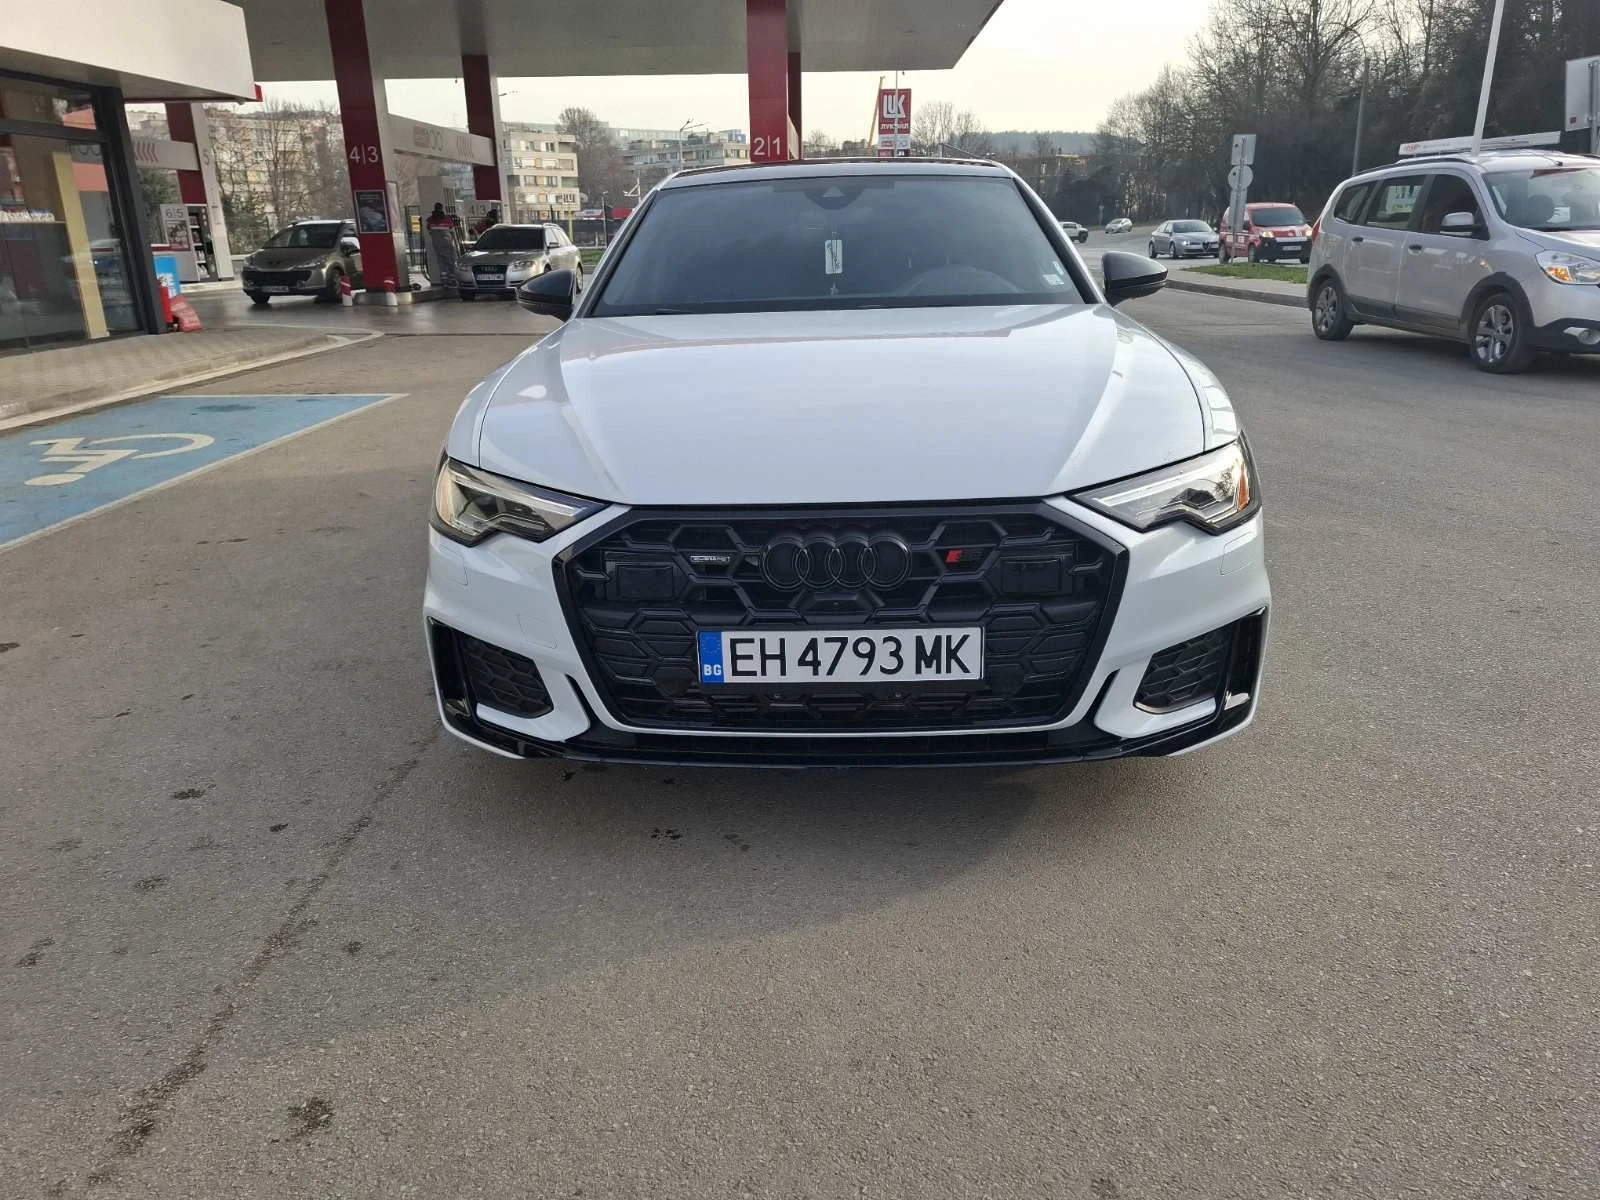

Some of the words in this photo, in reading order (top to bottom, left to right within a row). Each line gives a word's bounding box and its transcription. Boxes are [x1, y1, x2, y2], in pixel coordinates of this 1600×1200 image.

[729, 637, 788, 677] EH
[797, 635, 905, 676] 4793
[914, 634, 972, 675] MK
[703, 664, 723, 677] BG
